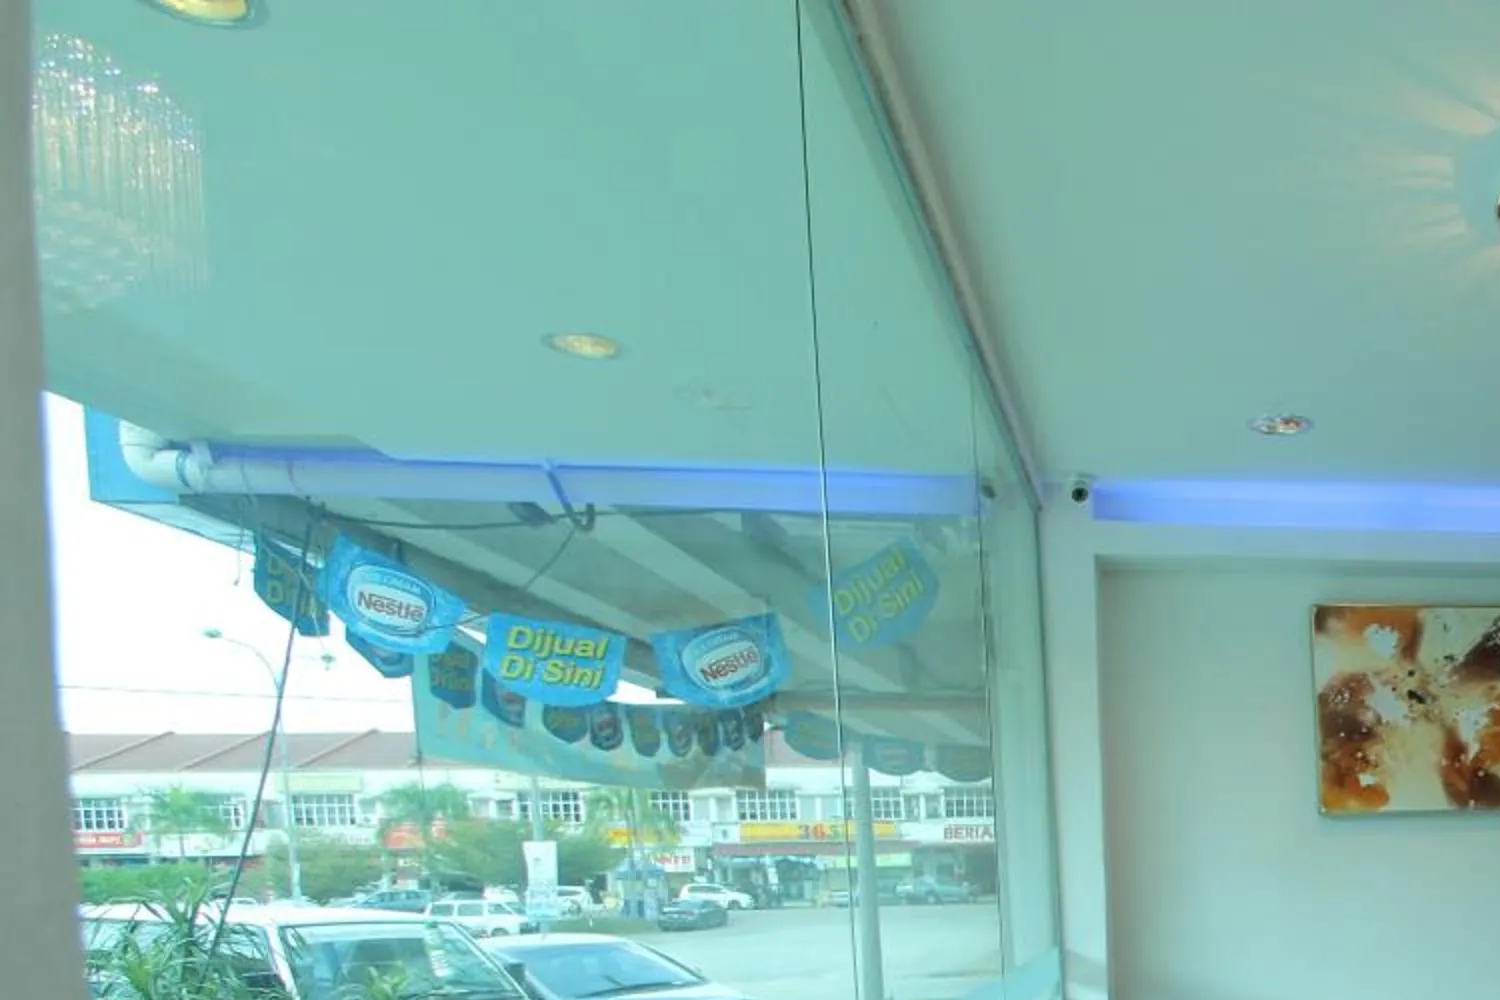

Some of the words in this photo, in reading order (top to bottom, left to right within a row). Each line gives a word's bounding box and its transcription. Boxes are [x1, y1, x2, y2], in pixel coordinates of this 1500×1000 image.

[834, 548, 905, 617] Dijual
[879, 569, 924, 619] Sini
[507, 625, 609, 660] Dijual
[500, 654, 534, 681] Di
[543, 659, 605, 689] Sini
